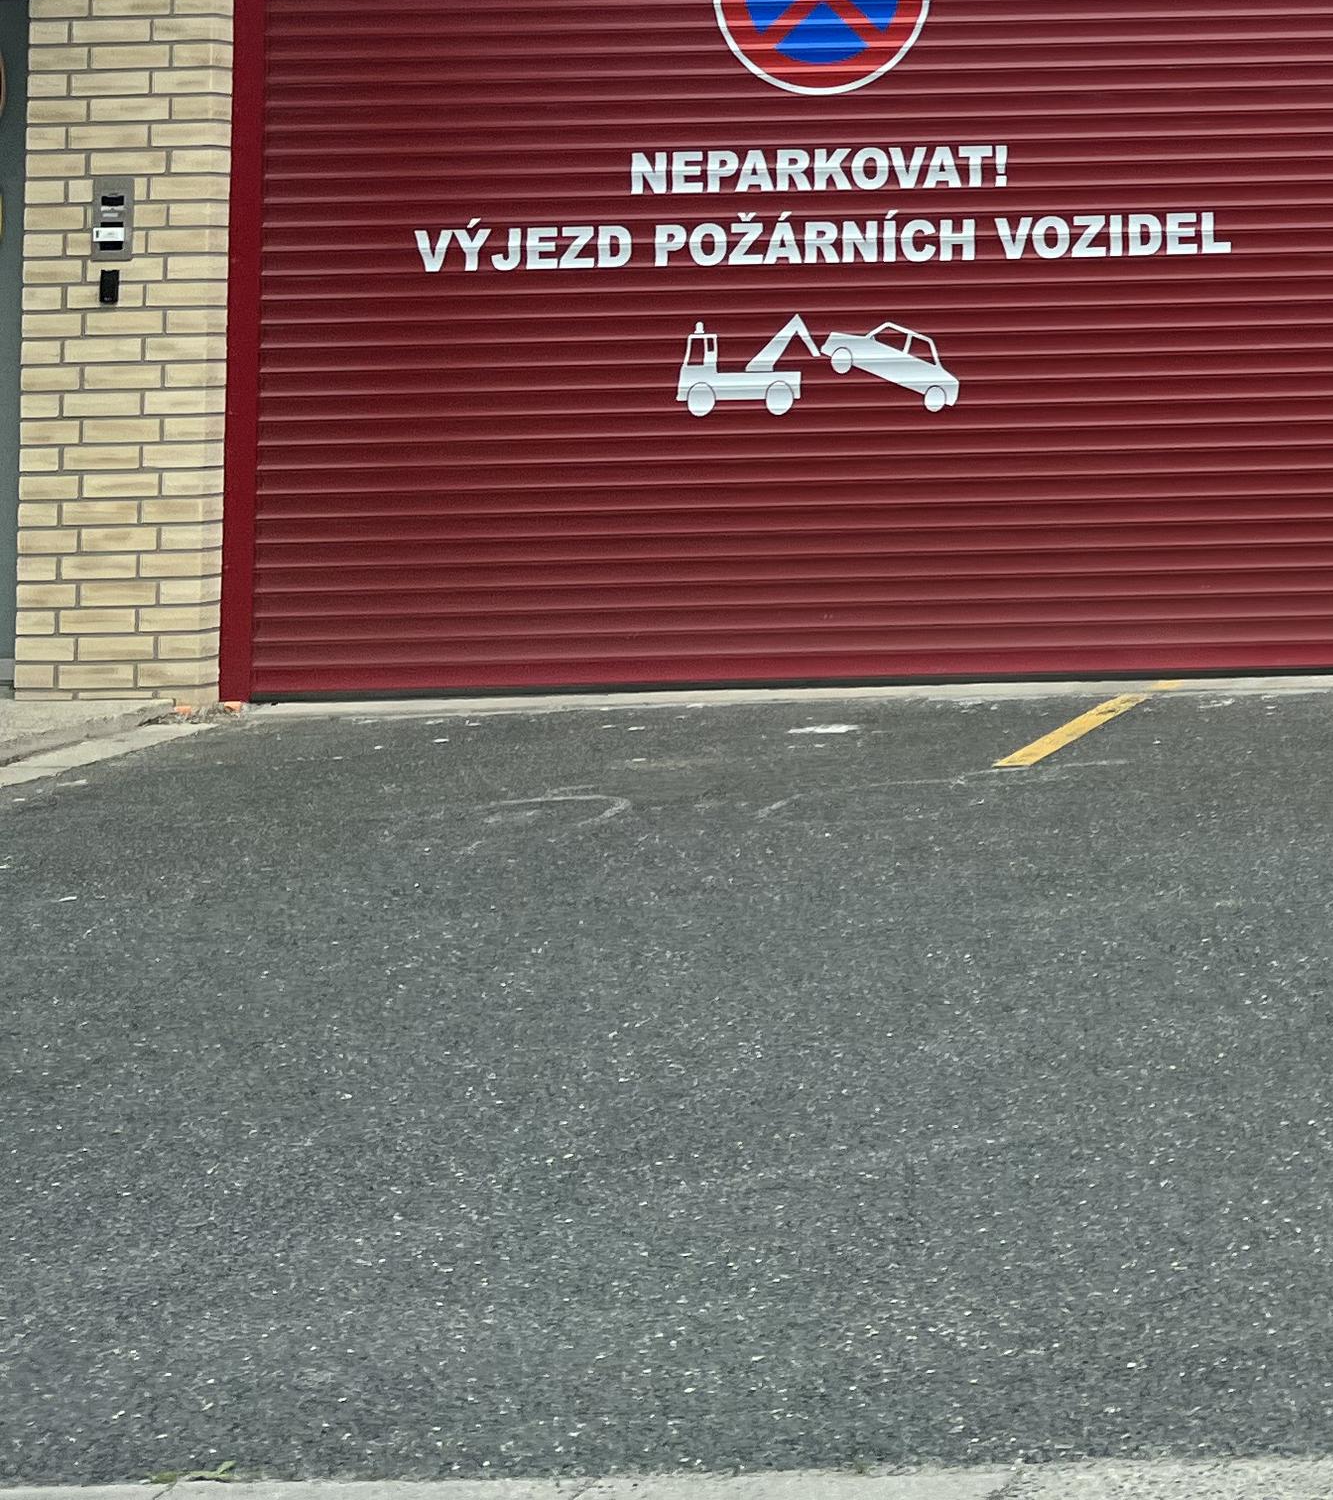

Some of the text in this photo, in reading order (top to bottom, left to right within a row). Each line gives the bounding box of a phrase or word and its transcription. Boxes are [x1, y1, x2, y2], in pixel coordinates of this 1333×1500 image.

[630, 144, 1008, 195] NEPARKOVAT!
[414, 208, 1232, 273] VÝJEZD POŽÁRNÍCH VOZIDEL
